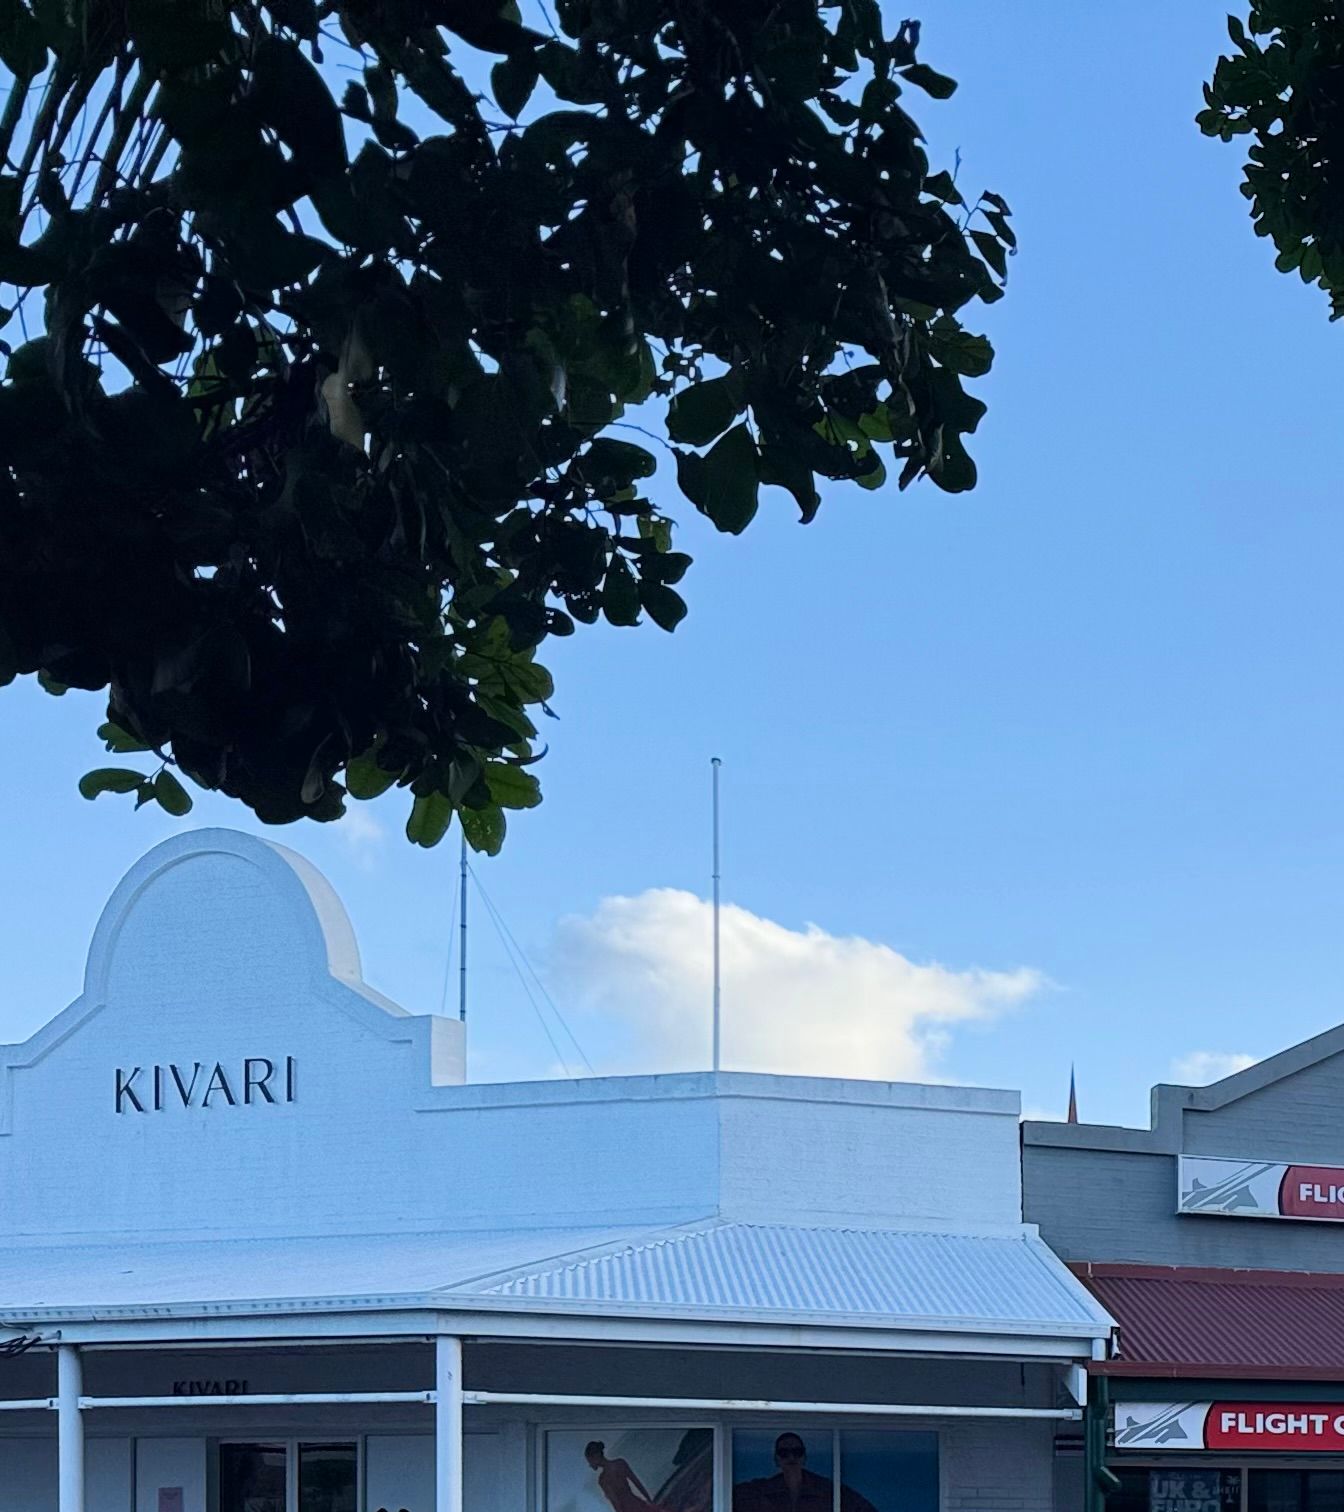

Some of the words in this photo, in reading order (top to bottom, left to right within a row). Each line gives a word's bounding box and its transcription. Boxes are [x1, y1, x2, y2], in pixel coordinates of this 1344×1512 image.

[115, 1056, 293, 1114] KIVARI
[1220, 1412, 1329, 1435] FLIGHT
[1152, 1479, 1187, 1499] UK
[1191, 1480, 1212, 1499] &
